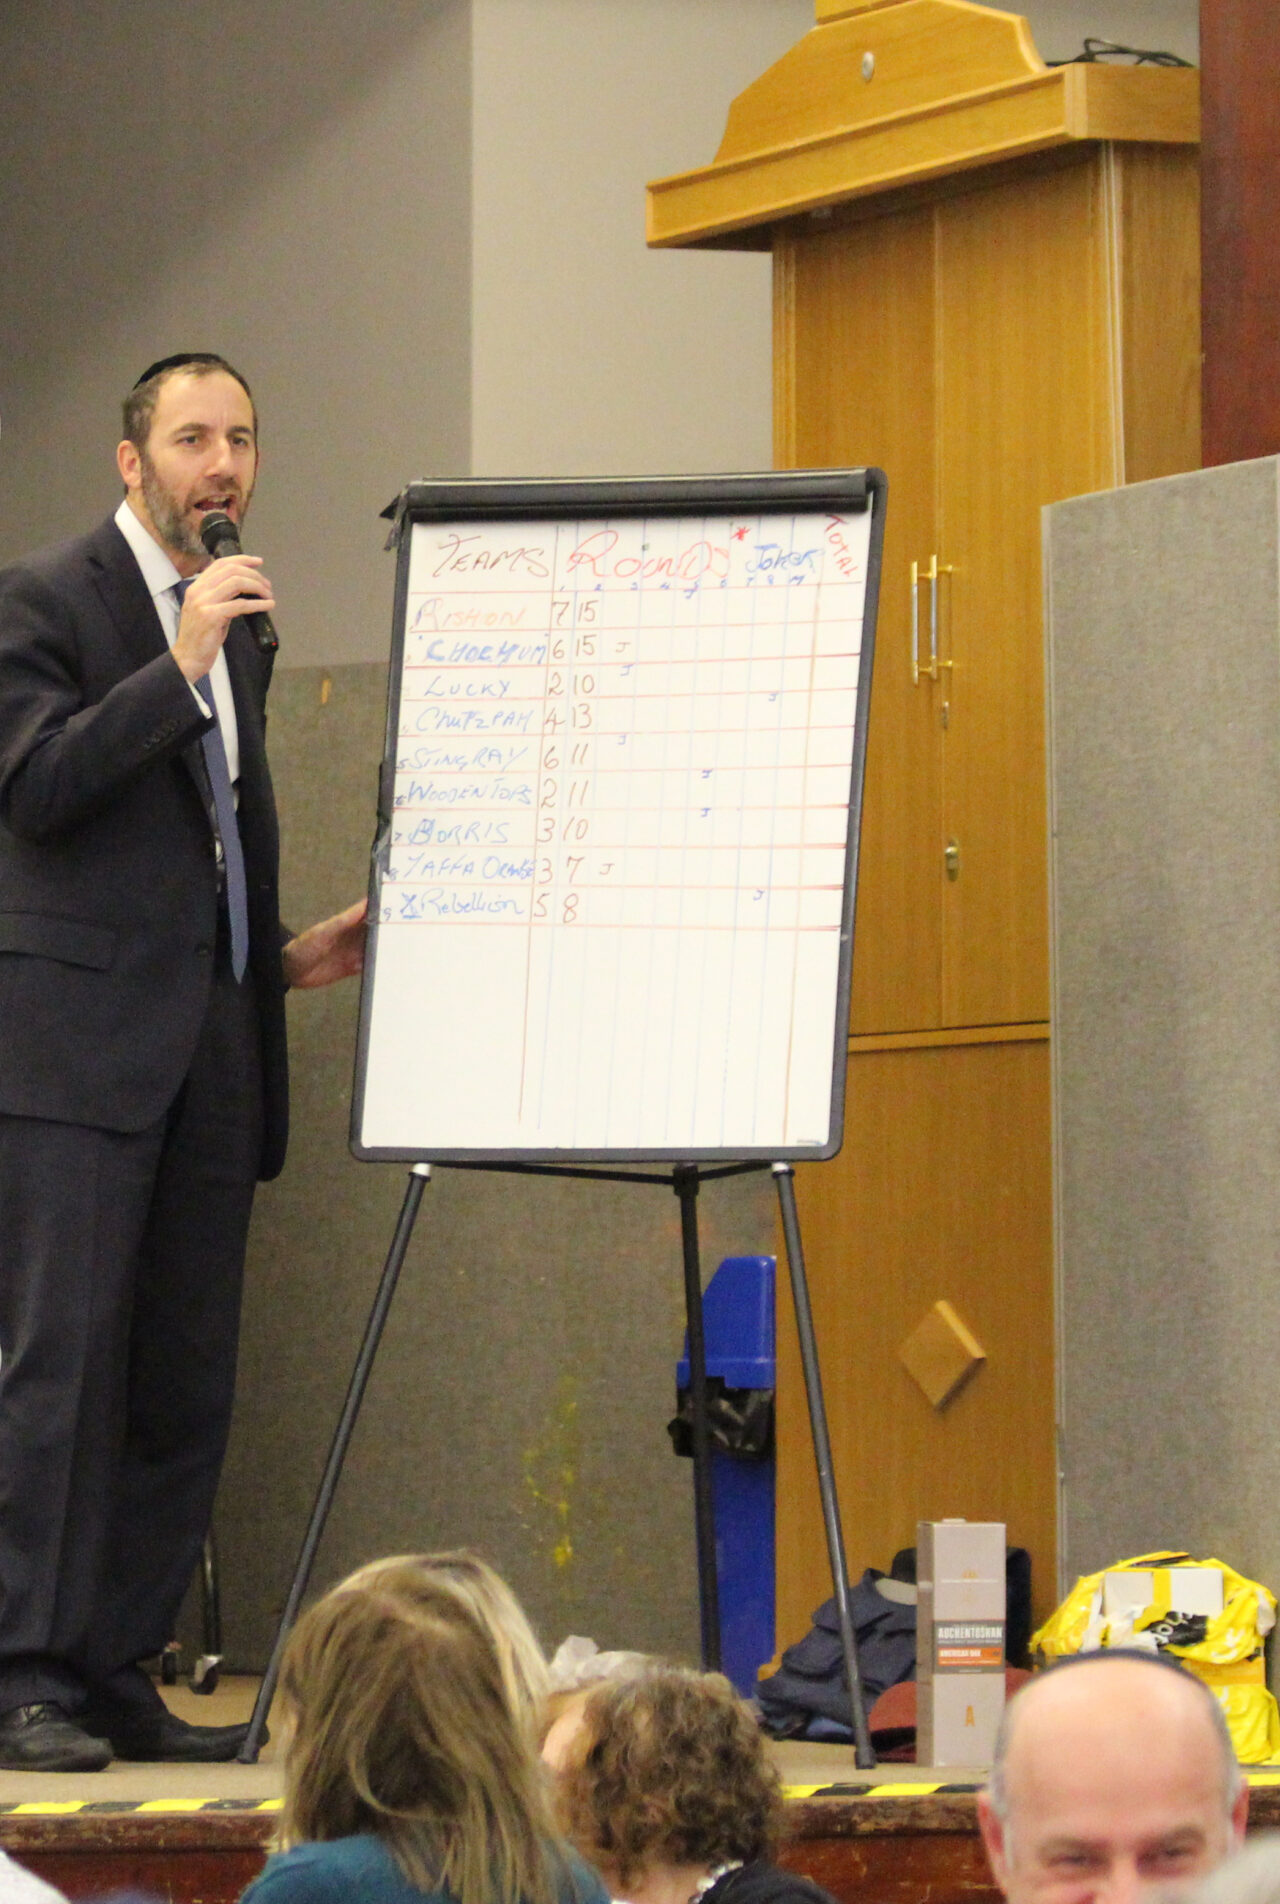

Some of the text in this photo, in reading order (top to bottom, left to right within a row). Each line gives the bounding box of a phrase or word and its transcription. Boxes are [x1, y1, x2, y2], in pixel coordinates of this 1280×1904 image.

[432, 533, 550, 578] TEAMS
[552, 601, 570, 626] 7
[578, 600, 599, 622] 15
[552, 639, 565, 659] 6
[576, 634, 597, 657] 15
[424, 676, 510, 698] LUCKY
[548, 672, 564, 696] 2
[574, 675, 595, 696] 10
[545, 707, 565, 734] 4
[573, 703, 593, 729] 13
[543, 746, 559, 770] 6
[541, 778, 558, 809] 2
[537, 817, 556, 843] 3
[563, 815, 589, 841] 10
[538, 857, 553, 884] 3
[566, 855, 585, 883] 7
[534, 893, 550, 917] 5
[563, 893, 580, 924] 8
